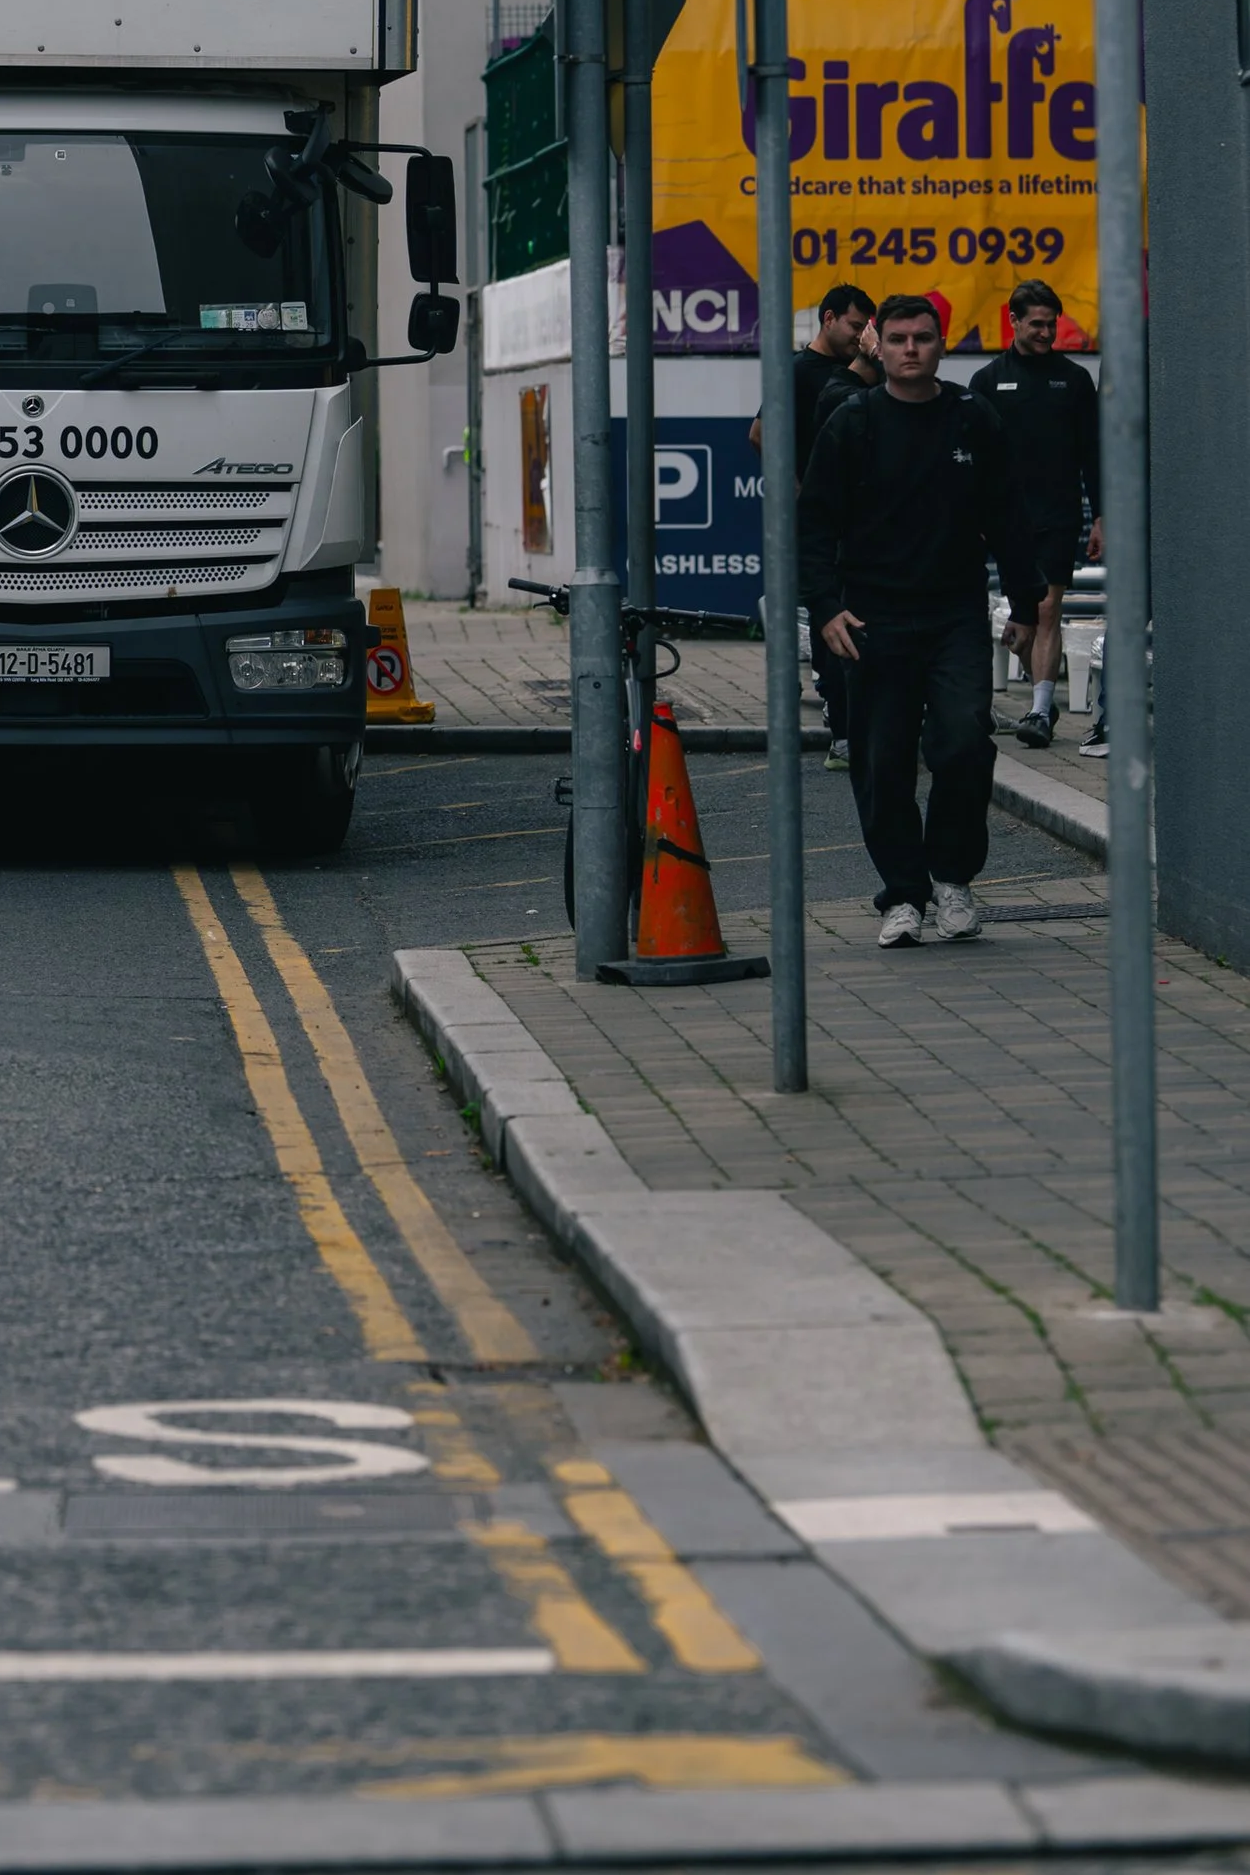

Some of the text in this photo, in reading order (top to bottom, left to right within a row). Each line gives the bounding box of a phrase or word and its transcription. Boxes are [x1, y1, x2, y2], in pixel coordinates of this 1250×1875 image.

[740, 175, 852, 196] Cdcare
[858, 173, 905, 195] that
[911, 175, 994, 199] shapes
[999, 180, 1012, 195] a
[793, 228, 1065, 265] 01 245 0939
[652, 289, 740, 333] NCI
[60, 425, 159, 459] 0000
[626, 554, 761, 575] SHLESS
